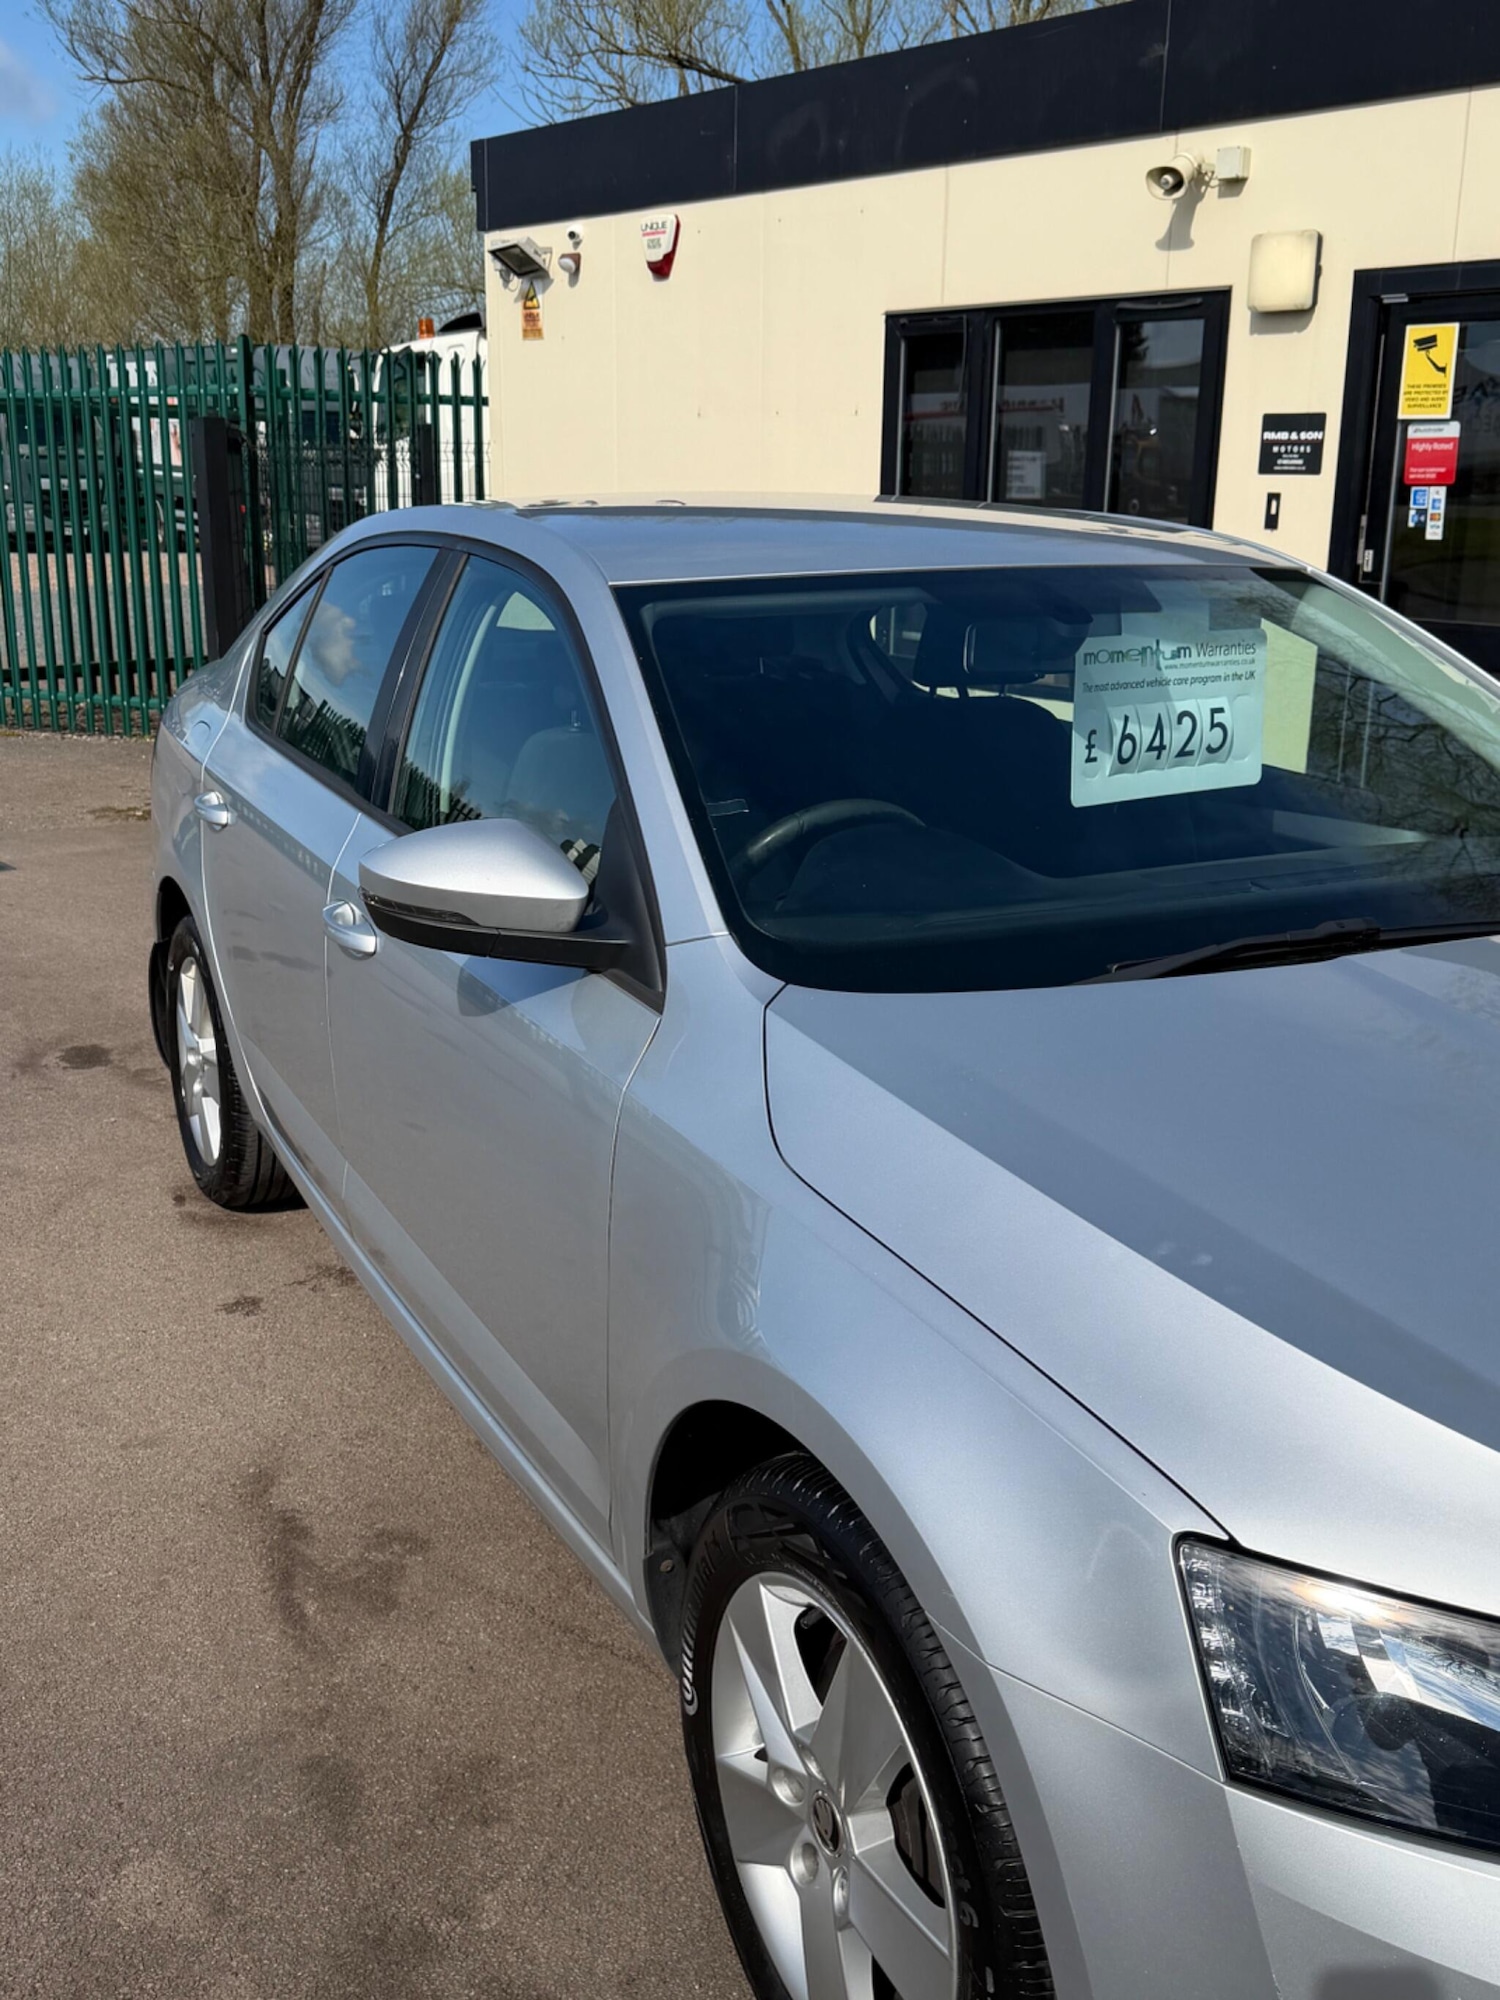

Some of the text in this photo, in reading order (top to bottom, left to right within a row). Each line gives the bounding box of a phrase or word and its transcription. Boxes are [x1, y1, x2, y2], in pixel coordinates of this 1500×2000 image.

[1289, 431, 1298, 440] &
[1299, 431, 1323, 440] SON
[1272, 445, 1311, 453] MOTORS
[1411, 442, 1454, 453] Highly Rated
[1083, 638, 1257, 671] momentum Warranties
[1164, 657, 1256, 671] www.momentumwarranties.co.uk
[1082, 670, 1256, 693] The most advanced vehicle care program in the UK
[1084, 706, 1229, 766] £ 6425
